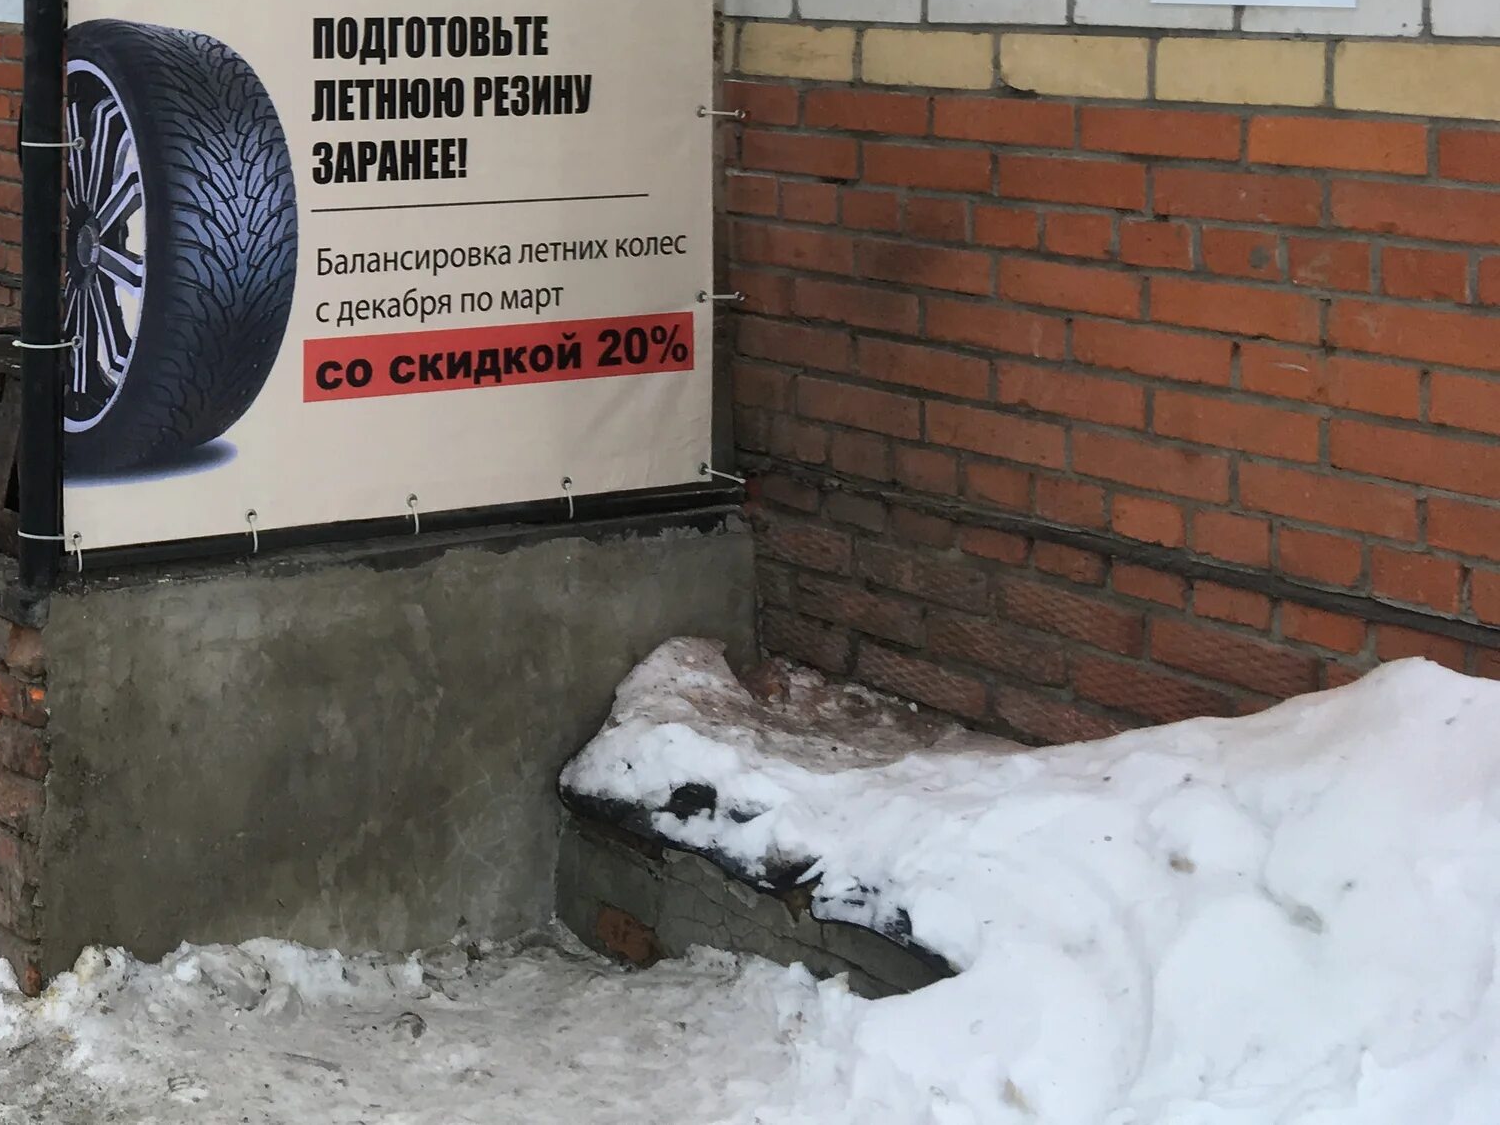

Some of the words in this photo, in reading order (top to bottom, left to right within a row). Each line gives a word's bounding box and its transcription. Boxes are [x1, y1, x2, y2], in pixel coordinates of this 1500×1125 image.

[312, 15, 549, 65] ПОДГОТОВЬТЕ
[311, 77, 465, 122] ЛЕТНЮЮ
[473, 74, 592, 118] РЕЗИНУ
[311, 138, 468, 185] ЗАРАНЕЕ!
[316, 241, 512, 277] Балансировка
[518, 237, 609, 264] летних
[615, 233, 688, 258] колес
[315, 300, 330, 323] с
[336, 288, 452, 327] декабря
[460, 290, 494, 314] по
[500, 285, 564, 320] март
[315, 358, 373, 391] со
[388, 332, 583, 385] скидкой
[596, 324, 689, 368] 20%
